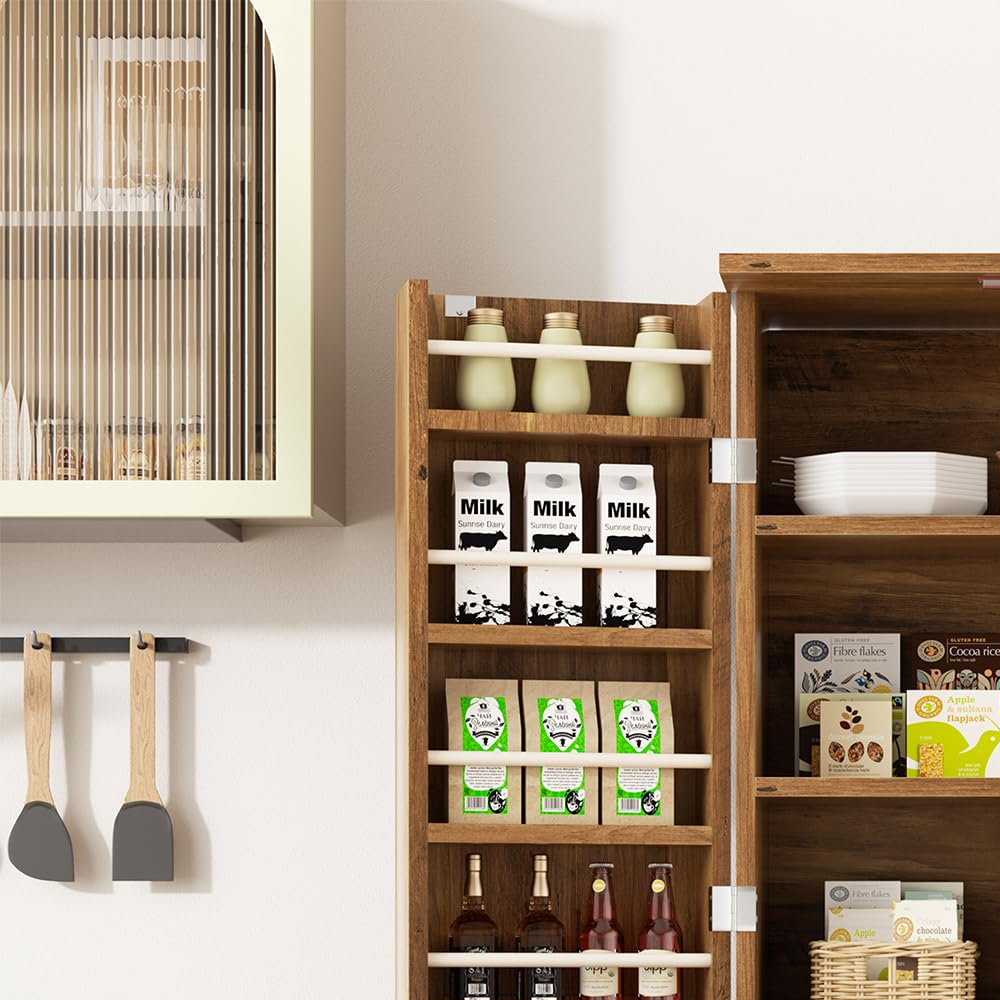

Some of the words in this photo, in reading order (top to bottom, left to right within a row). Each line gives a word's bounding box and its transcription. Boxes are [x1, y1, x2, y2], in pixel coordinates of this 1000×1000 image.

[461, 499, 504, 515] Milk
[533, 500, 576, 517] Milk
[607, 502, 651, 518] Milk
[457, 520, 485, 528] Sunrise
[486, 521, 505, 529] Dairy
[559, 522, 578, 531] Dairy
[604, 523, 631, 531] Sunrise
[633, 524, 652, 532] Dairy
[833, 646, 857, 656] Fibre
[859, 645, 887, 656] flakes
[949, 646, 980, 656] Cocoa
[983, 646, 1000, 656] rice
[947, 695, 976, 704] Apple
[957, 705, 993, 713] sultana
[947, 715, 986, 724] flapjack
[852, 889, 871, 897] Fibre
[871, 889, 891, 897] flakes
[853, 928, 876, 938] Apple
[916, 926, 952, 935] chocolate
